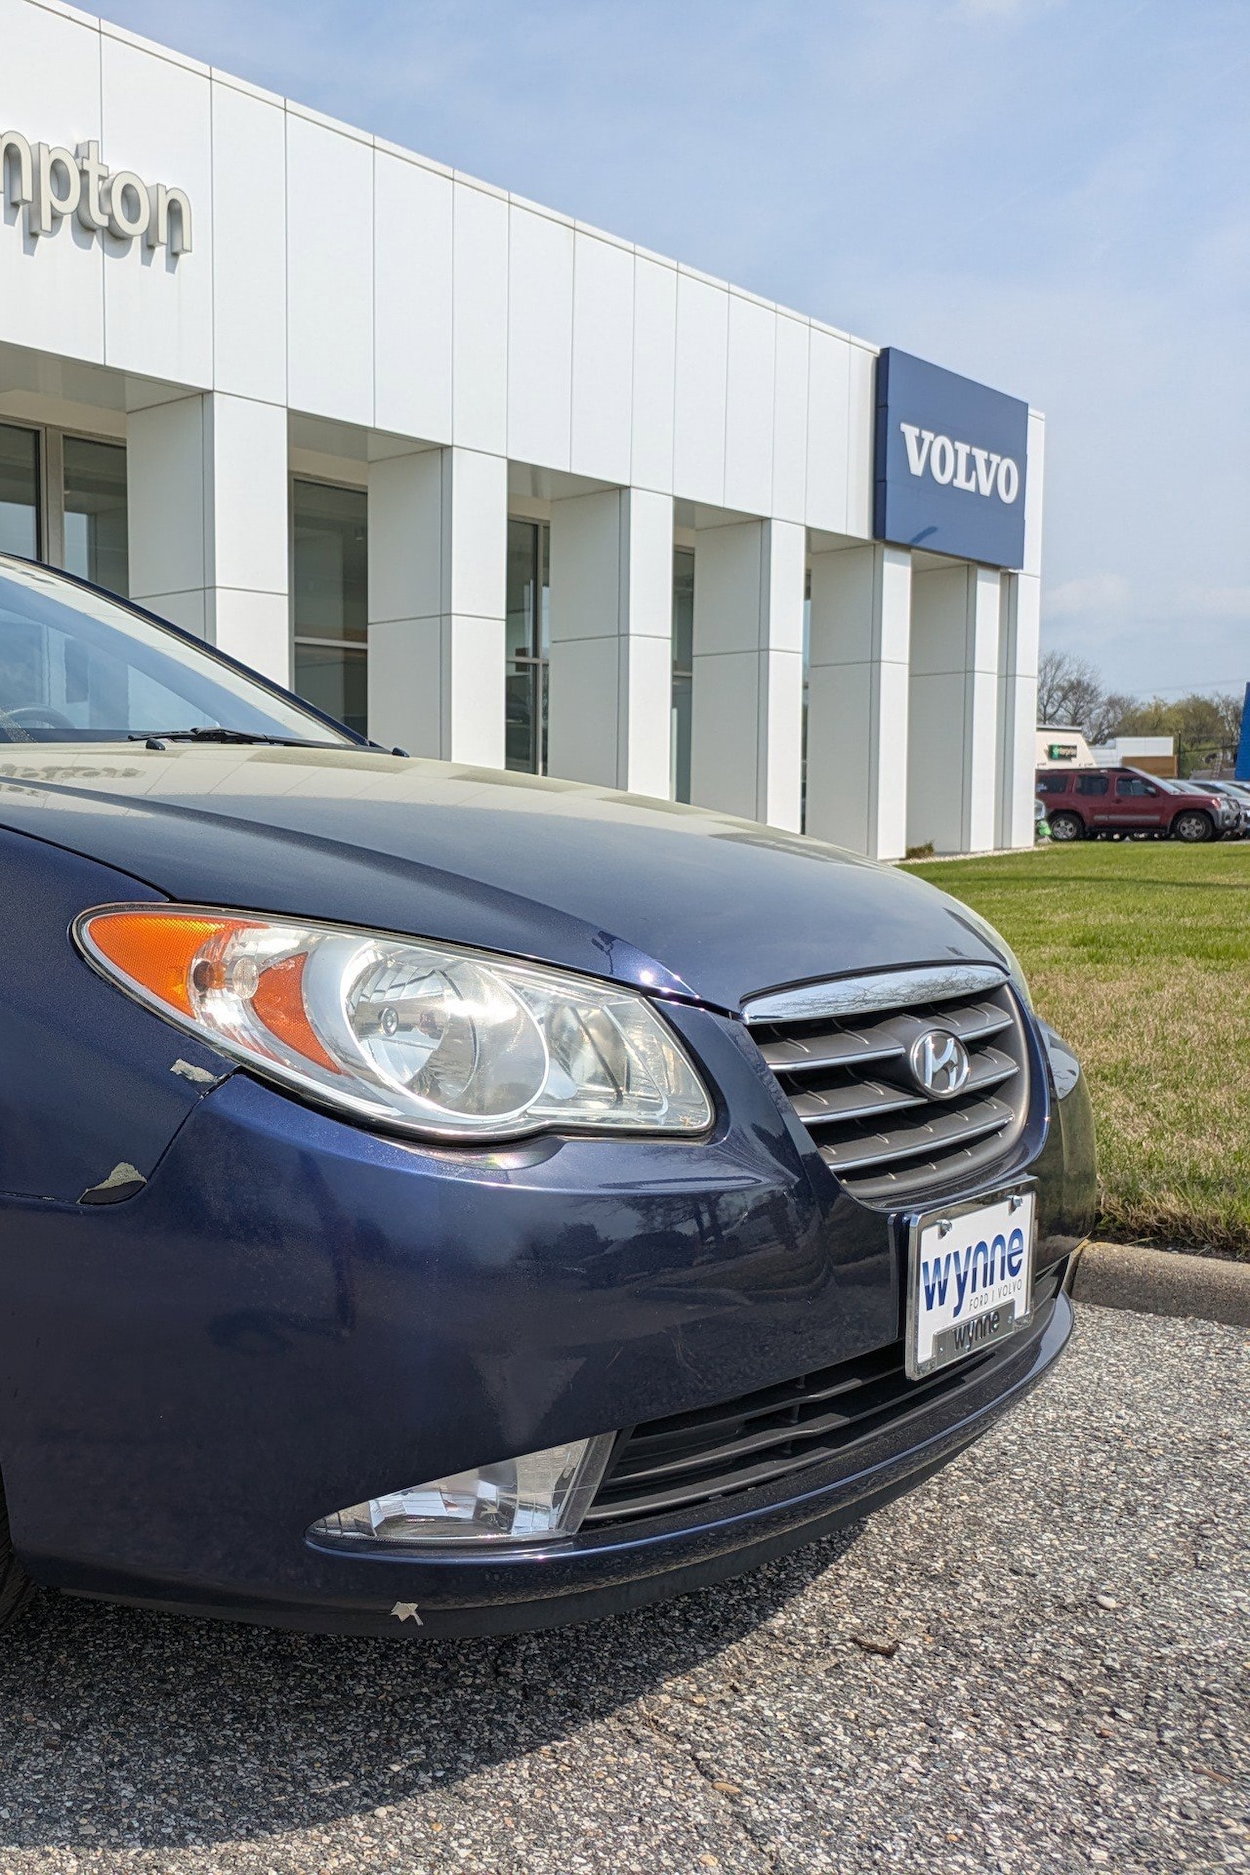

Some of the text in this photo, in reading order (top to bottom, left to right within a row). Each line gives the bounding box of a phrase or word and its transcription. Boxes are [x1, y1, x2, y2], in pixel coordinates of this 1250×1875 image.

[900, 422, 1019, 504] VOLVO
[922, 1227, 1024, 1318] wynne
[969, 1293, 989, 1312] FORD
[998, 1279, 1023, 1299] VOLVO
[953, 1311, 1000, 1352] wynne
